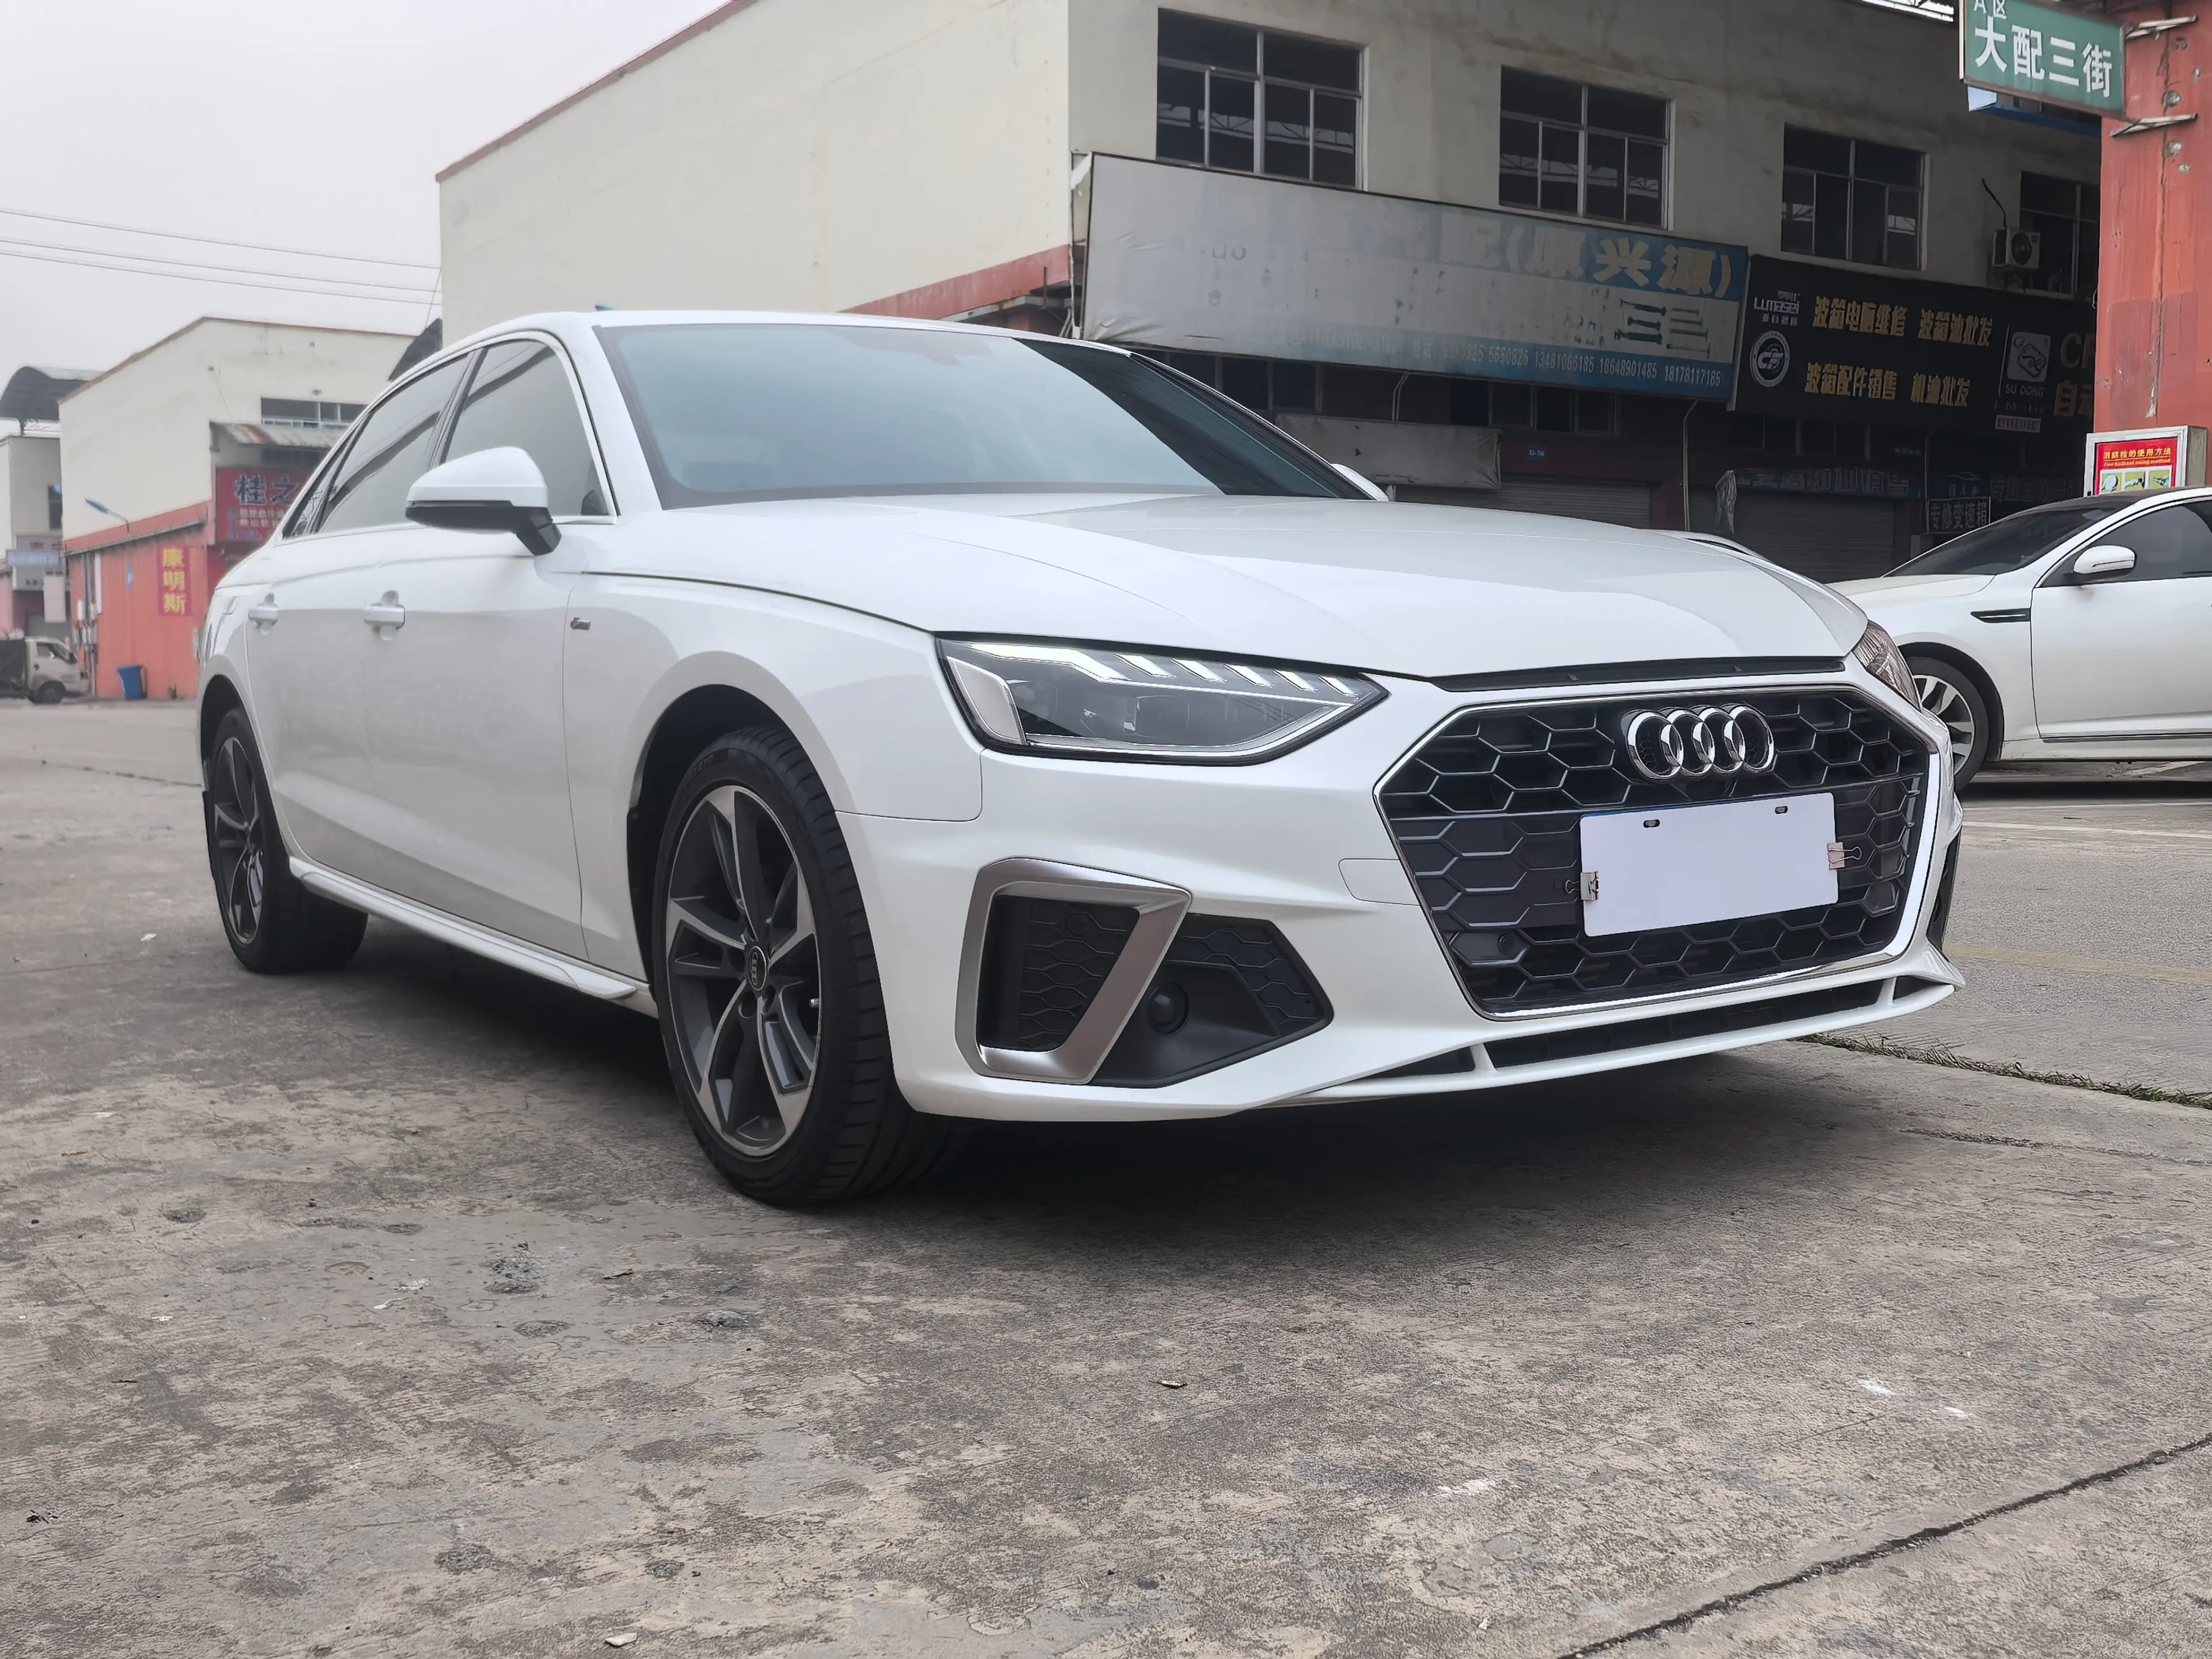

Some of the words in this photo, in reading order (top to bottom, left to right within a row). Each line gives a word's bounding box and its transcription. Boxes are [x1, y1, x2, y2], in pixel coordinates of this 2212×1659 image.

[1975, 16, 2112, 97] 大配三街
[1918, 309, 1993, 347] 波箱油批发
[1600, 357, 1658, 378] 18648901485
[1665, 365, 1722, 387] 18178117185
[1805, 362, 1897, 400] 波箱配件销售
[1911, 373, 1970, 407] 机油批发
[2103, 447, 2171, 460] 消防栓的使用方法
[1930, 500, 1987, 531] 专修变速箱
